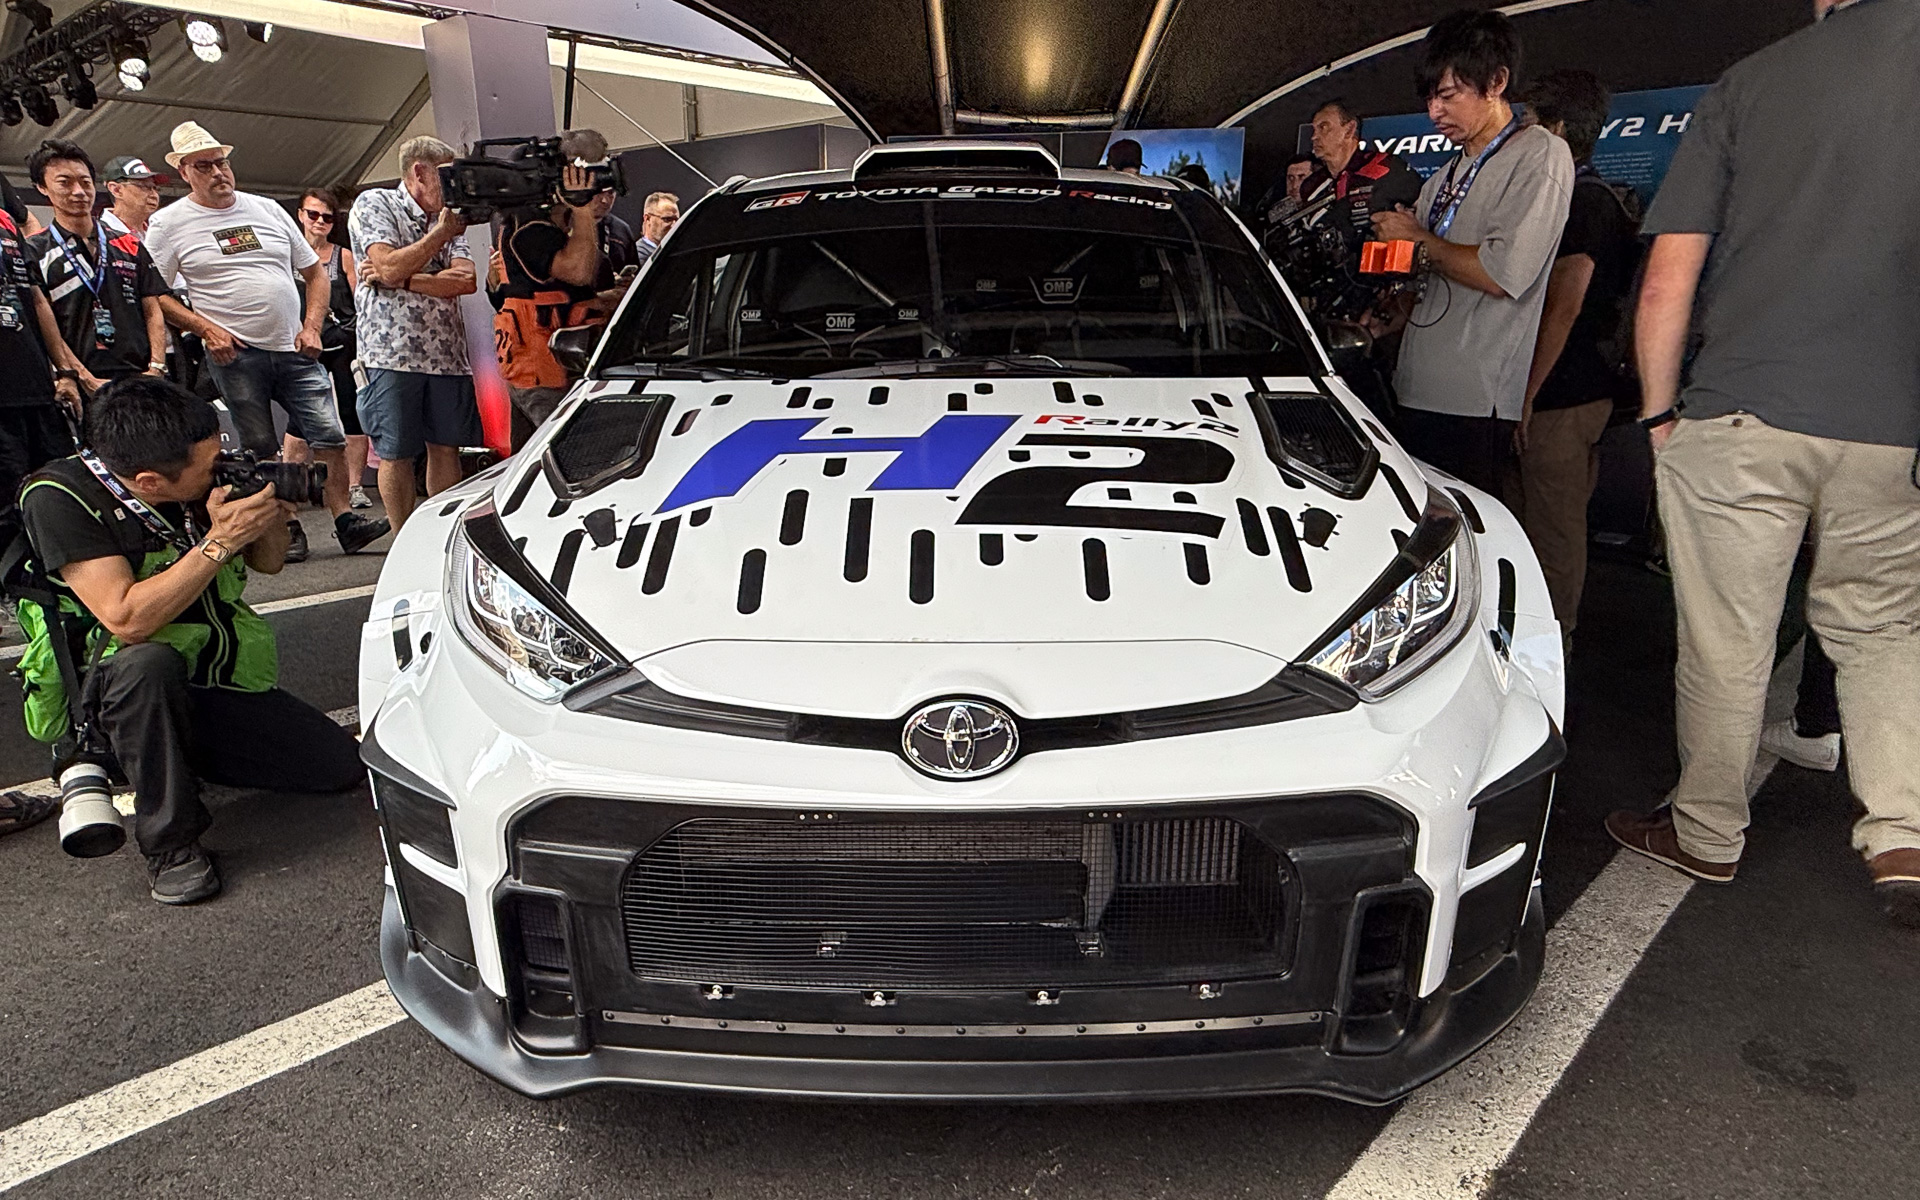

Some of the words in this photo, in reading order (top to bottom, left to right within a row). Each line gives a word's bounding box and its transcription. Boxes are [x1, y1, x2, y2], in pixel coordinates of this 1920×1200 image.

[1374, 134, 1464, 155] YARI
[750, 194, 806, 211] GR
[815, 186, 939, 201] TOYOTA
[947, 185, 1062, 197] GAZOO
[1068, 190, 1173, 210] Racing
[976, 279, 997, 290] OMP
[1043, 280, 1074, 294] OMP
[741, 309, 762, 321] OMP
[898, 309, 919, 319] OMP
[826, 315, 856, 329] OMP
[1033, 414, 1240, 439] Rally2
